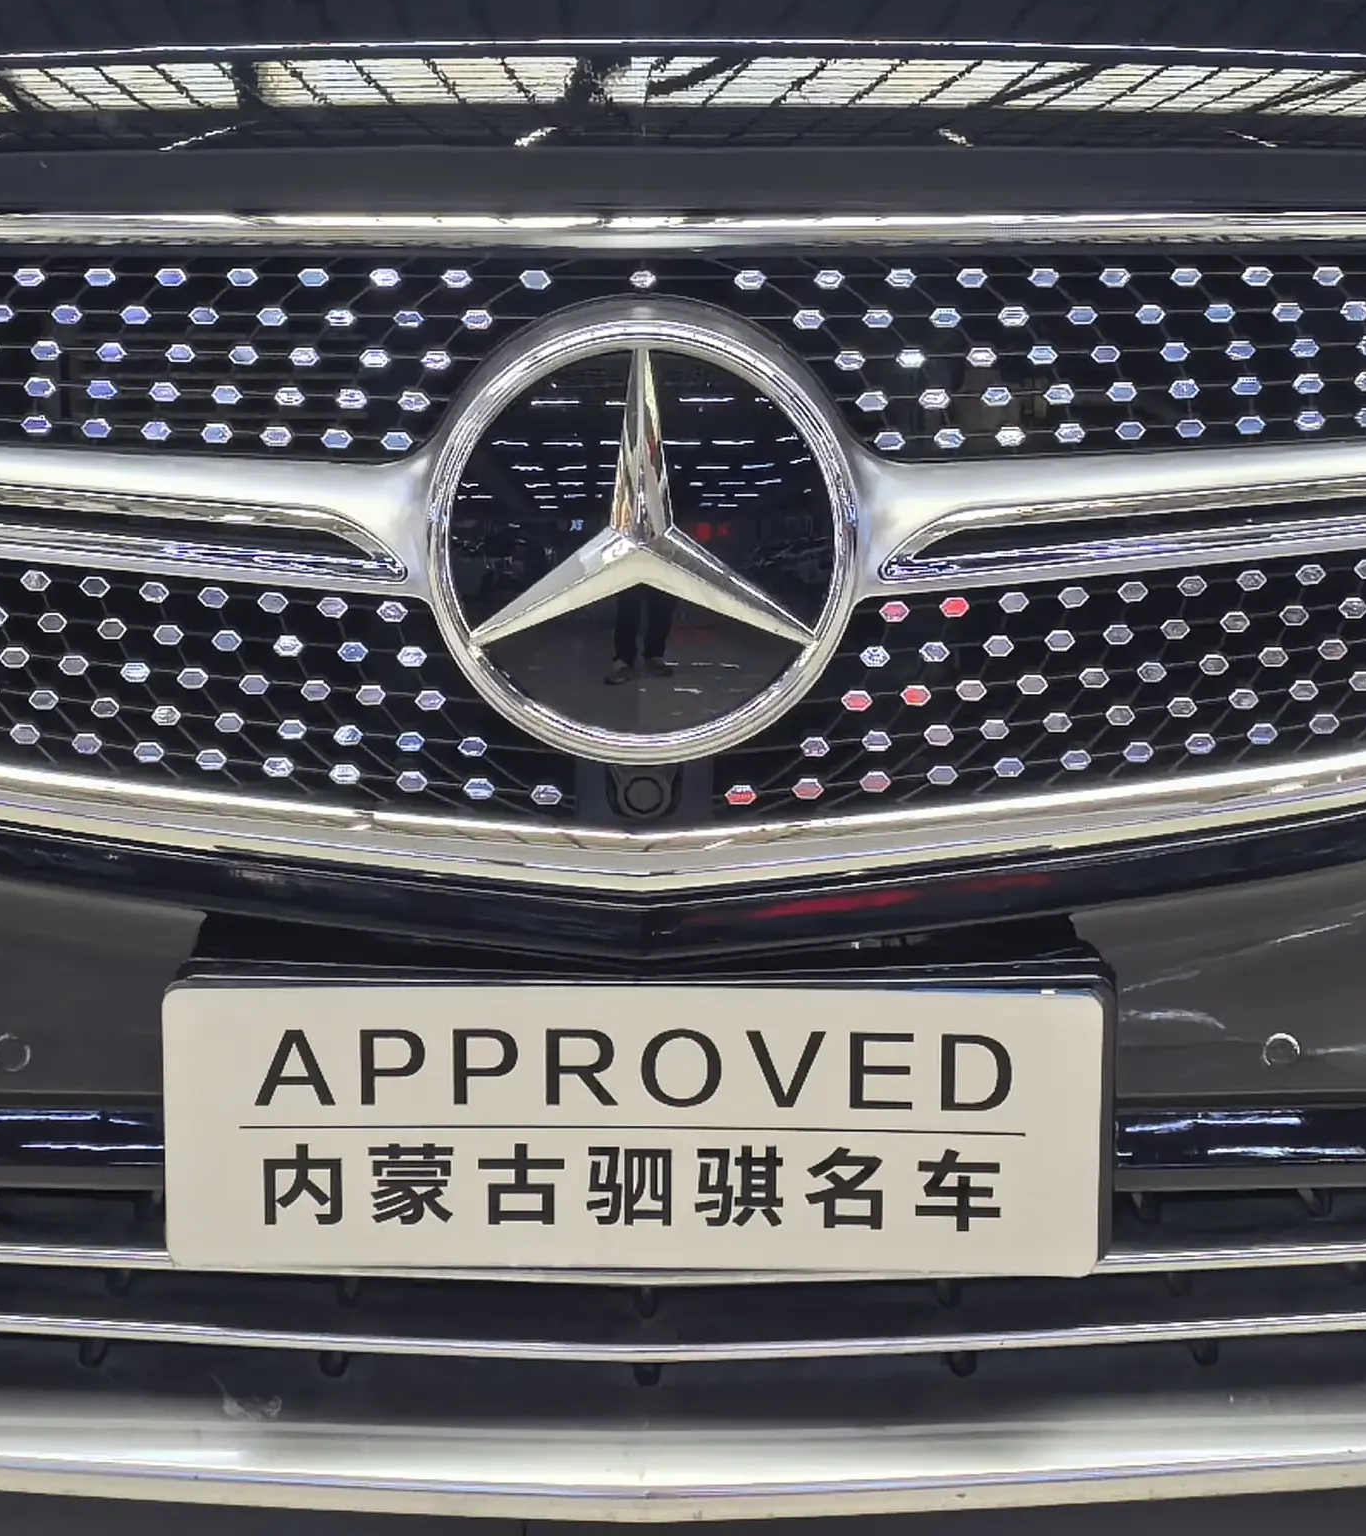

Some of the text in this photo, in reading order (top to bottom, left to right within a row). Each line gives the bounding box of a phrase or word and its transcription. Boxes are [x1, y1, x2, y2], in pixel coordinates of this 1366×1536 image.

[254, 1028, 1013, 1112] APPROVED
[262, 1143, 1003, 1232] 内蒙古驷骐名车
